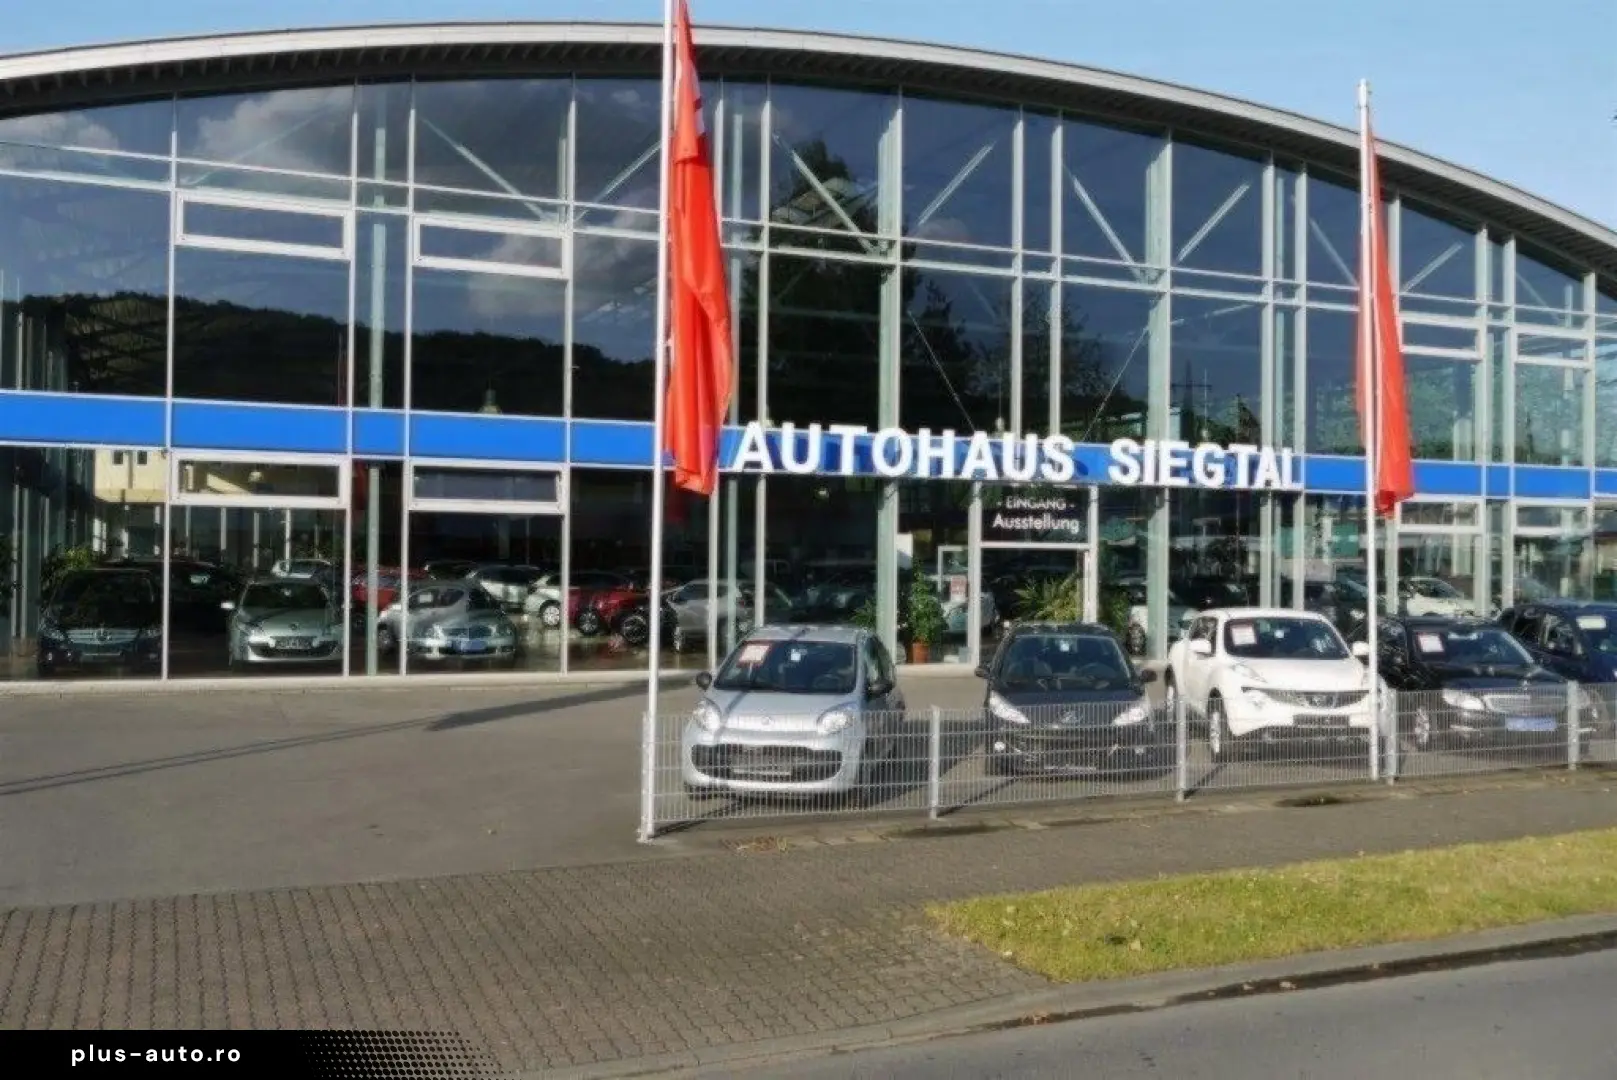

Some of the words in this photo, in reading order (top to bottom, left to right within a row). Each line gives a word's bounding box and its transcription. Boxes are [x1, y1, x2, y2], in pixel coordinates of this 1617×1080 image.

[731, 421, 1075, 481] AUTOHAUS
[1108, 438, 1304, 489] SIEGTAL
[992, 512, 1080, 534] Ausstellung
